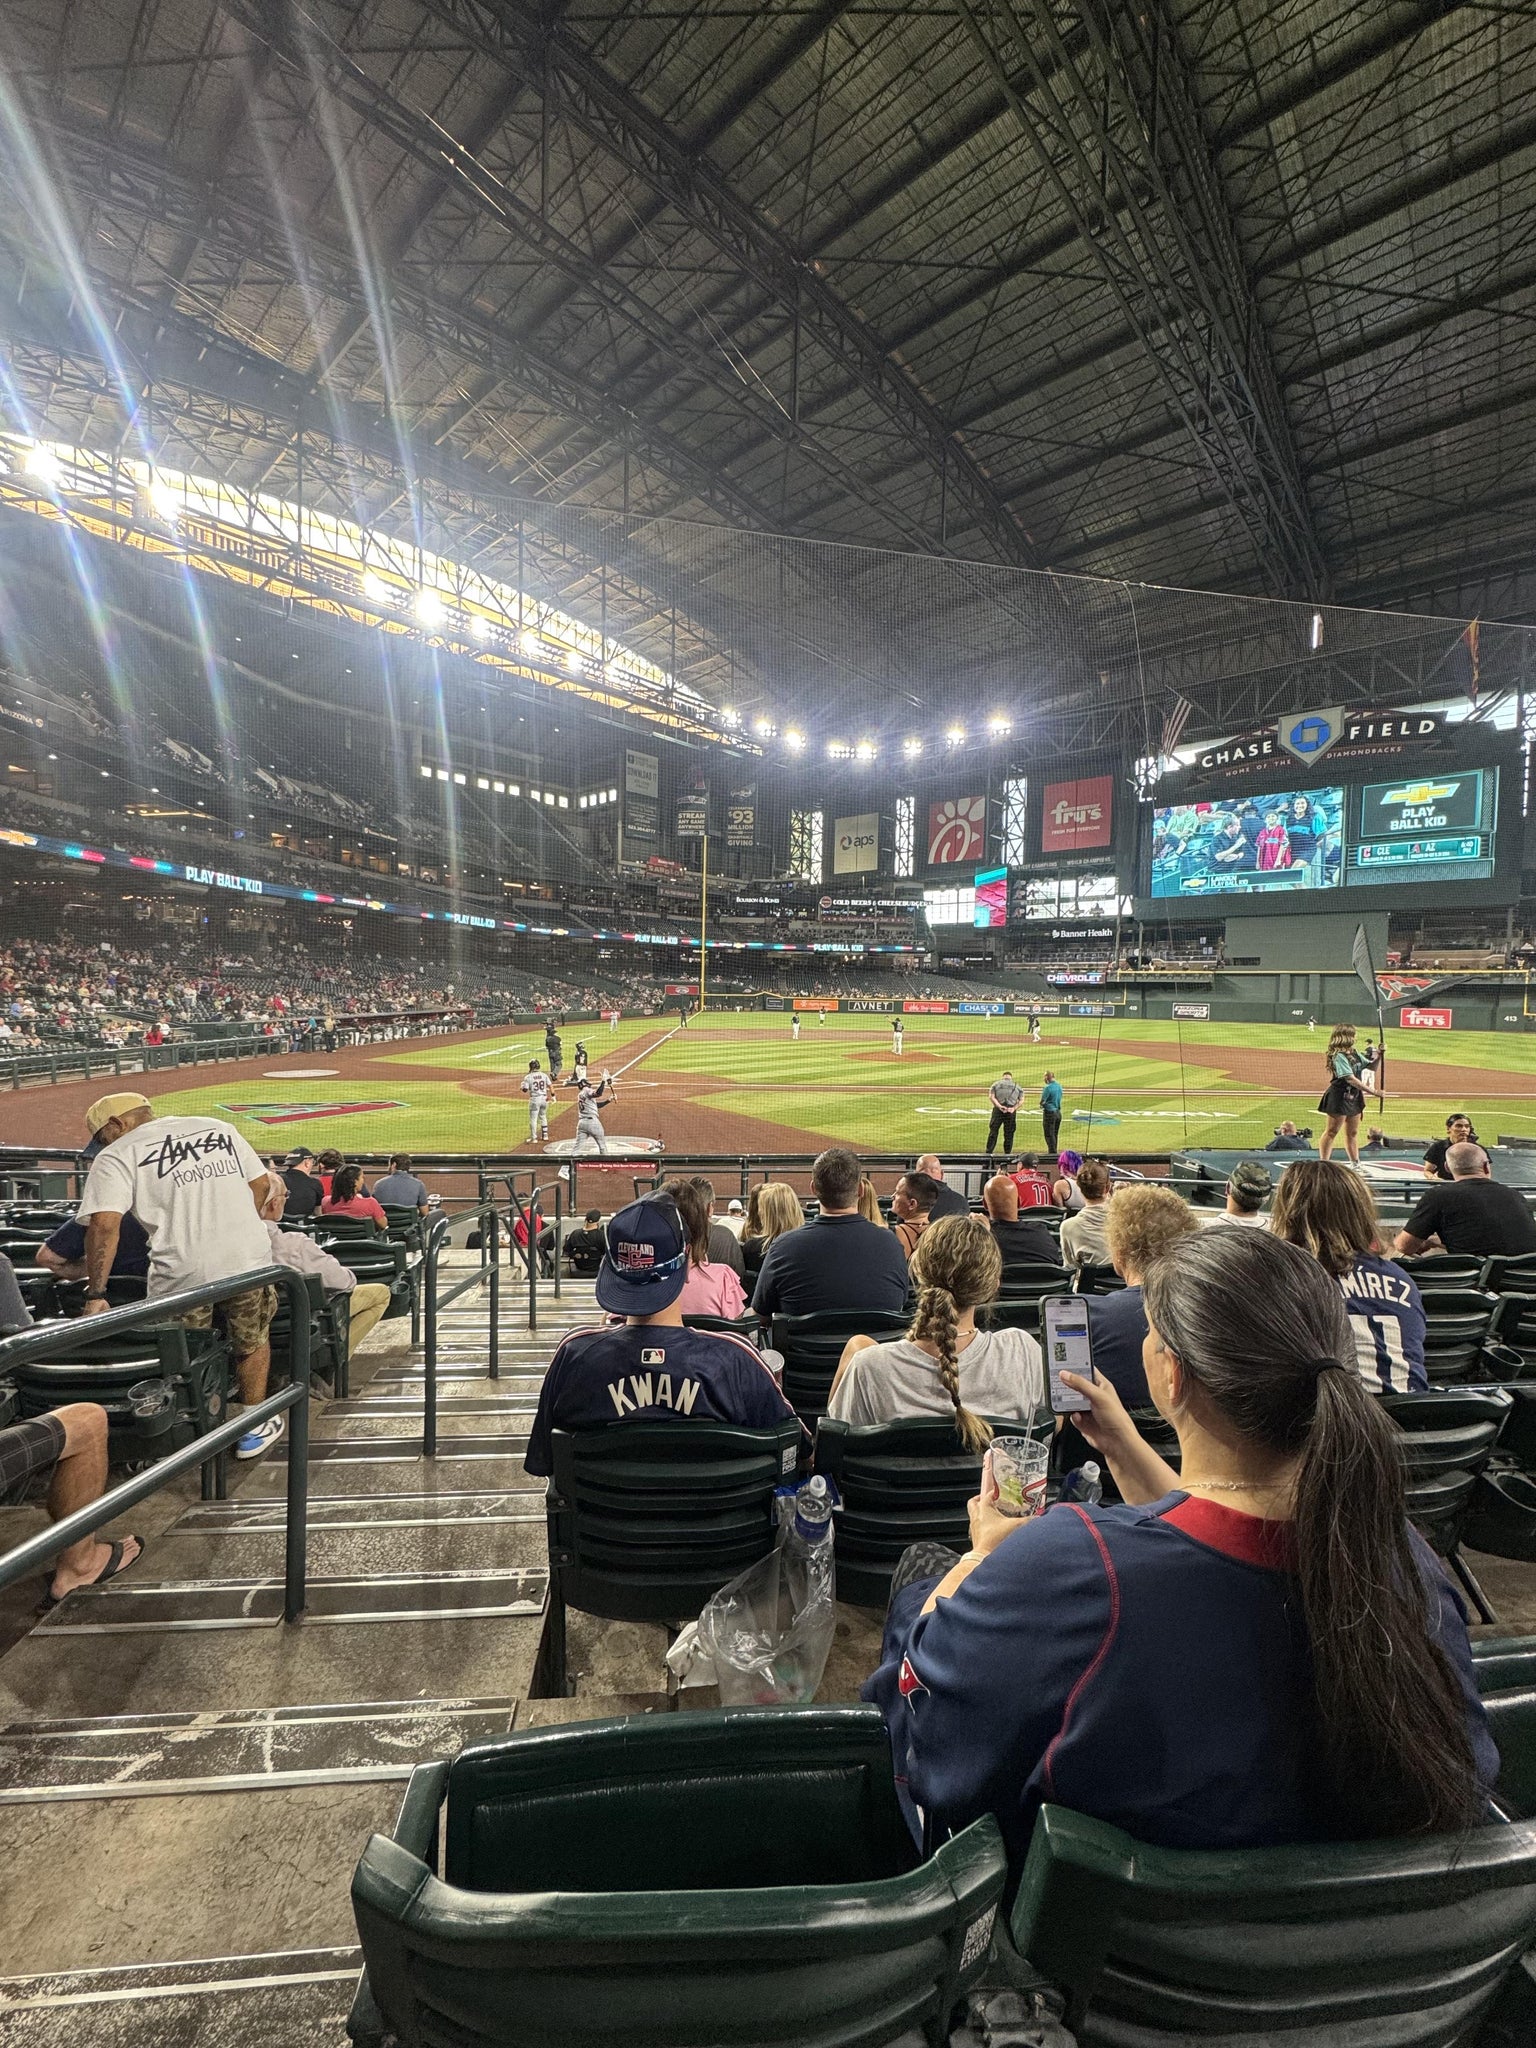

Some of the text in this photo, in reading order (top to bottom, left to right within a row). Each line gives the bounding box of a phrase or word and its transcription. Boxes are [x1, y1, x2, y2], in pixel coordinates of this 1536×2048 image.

[1201, 720, 1436, 768] CHASE FIELD
[1226, 746, 1402, 777] HOME OF THE DIAMONDBACKS
[728, 810, 754, 824] $93
[1050, 800, 1102, 825] fry's
[1402, 806, 1435, 819] PLAY
[1390, 816, 1447, 830] BALL KID
[854, 835, 874, 848] aps
[1425, 842, 1436, 852] AZ
[1377, 846, 1390, 856] CLE
[186, 866, 262, 894] PLAY BALL KID
[454, 913, 469, 924] PLAY
[470, 915, 485, 927] BALL
[635, 934, 650, 942] PLAY
[1087, 928, 1112, 937] Health
[1047, 974, 1101, 982] CHEVROLET
[853, 1002, 888, 1010] AVNET
[1406, 1010, 1446, 1026] fry's
[533, 1081, 545, 1091] 38
[172, 1159, 238, 1188] HONOLULU
[1032, 1183, 1049, 1205] 11
[618, 1242, 654, 1257] CLEVELAND
[1338, 1266, 1411, 1308] MÍREZ
[607, 1373, 700, 1417] KWAN
